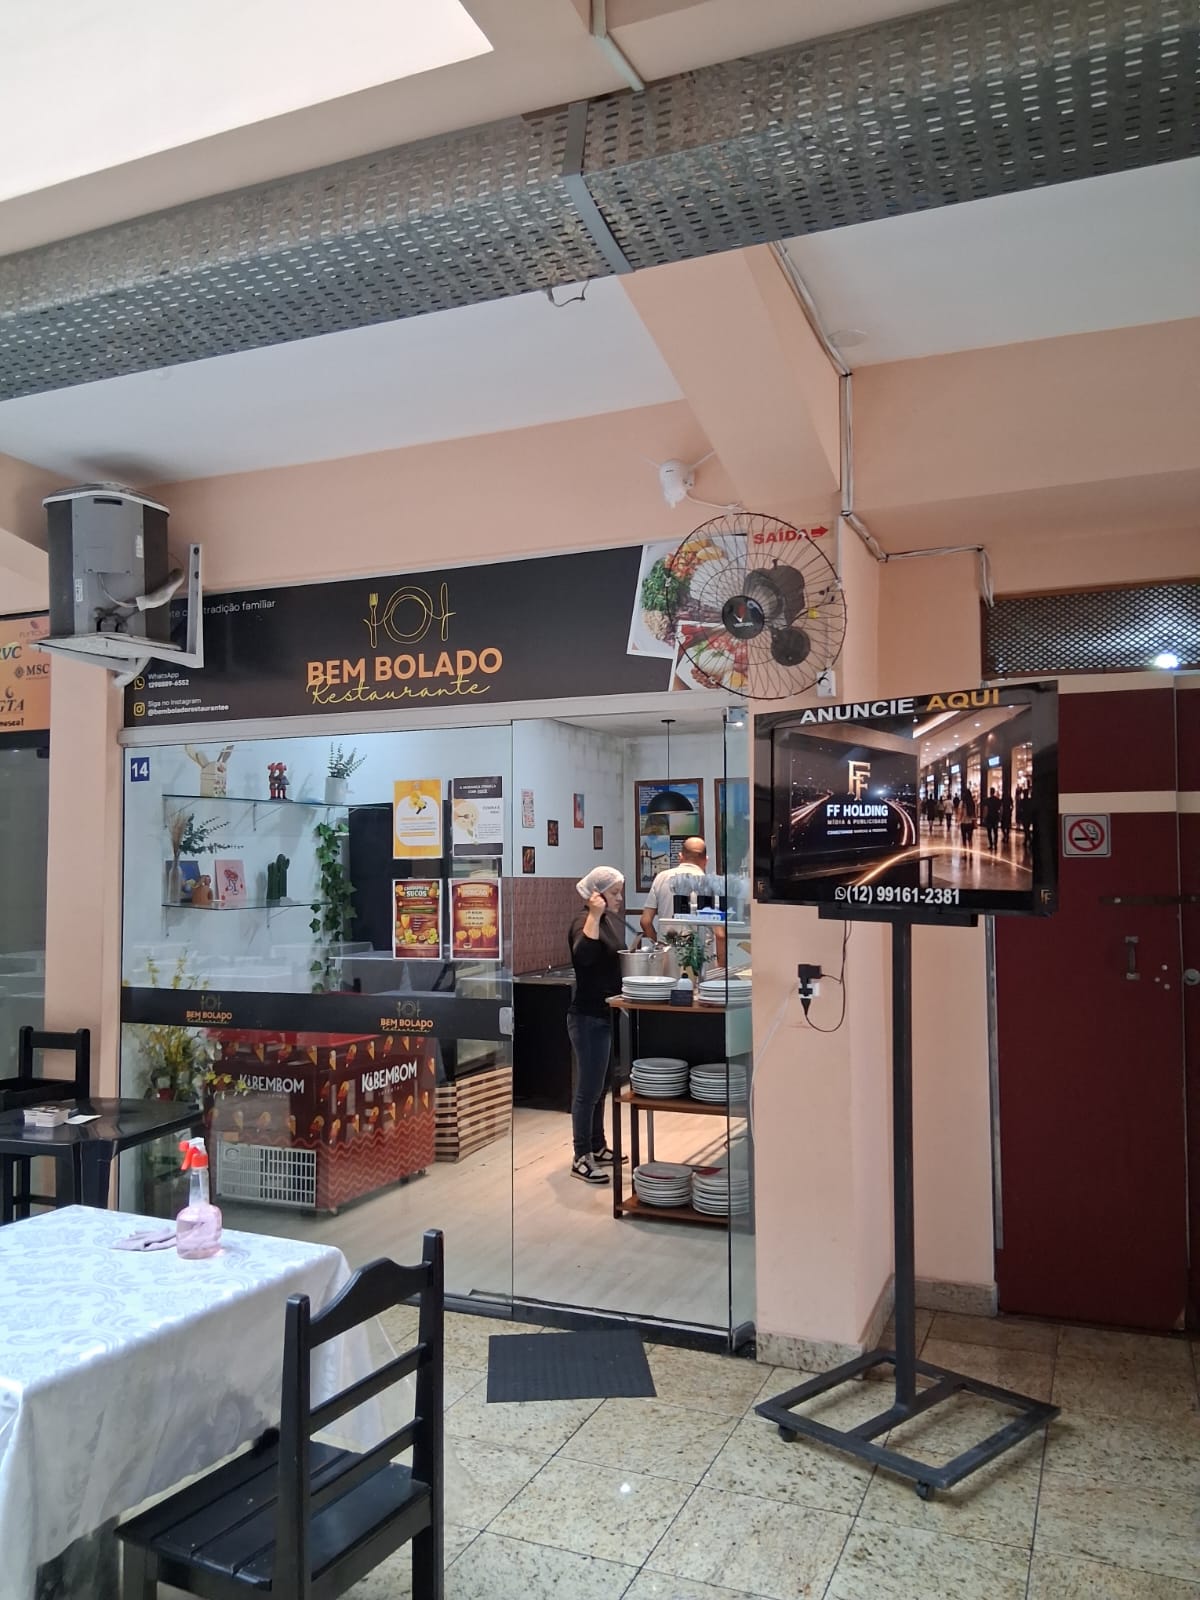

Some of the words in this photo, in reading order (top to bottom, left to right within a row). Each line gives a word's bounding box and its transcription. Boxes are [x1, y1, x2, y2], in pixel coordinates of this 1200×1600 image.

[203, 602, 240, 615] tradição
[242, 600, 276, 611] familiar
[26, 664, 49, 676] MSC
[307, 657, 366, 687] BEM
[375, 647, 503, 682] BOLADO
[306, 673, 490, 704] Restaurante
[800, 698, 915, 725] ANUNCIE
[926, 688, 999, 711] AQUI
[131, 761, 149, 778] 14
[826, 804, 841, 817] FF
[843, 804, 889, 817] HOLDING
[846, 885, 873, 904] (12)
[876, 886, 960, 905] 99161-2381
[186, 1010, 201, 1019] BEM
[202, 1011, 233, 1020] BOLADO
[380, 1017, 398, 1027] BEM
[399, 1018, 434, 1028] BOLADO
